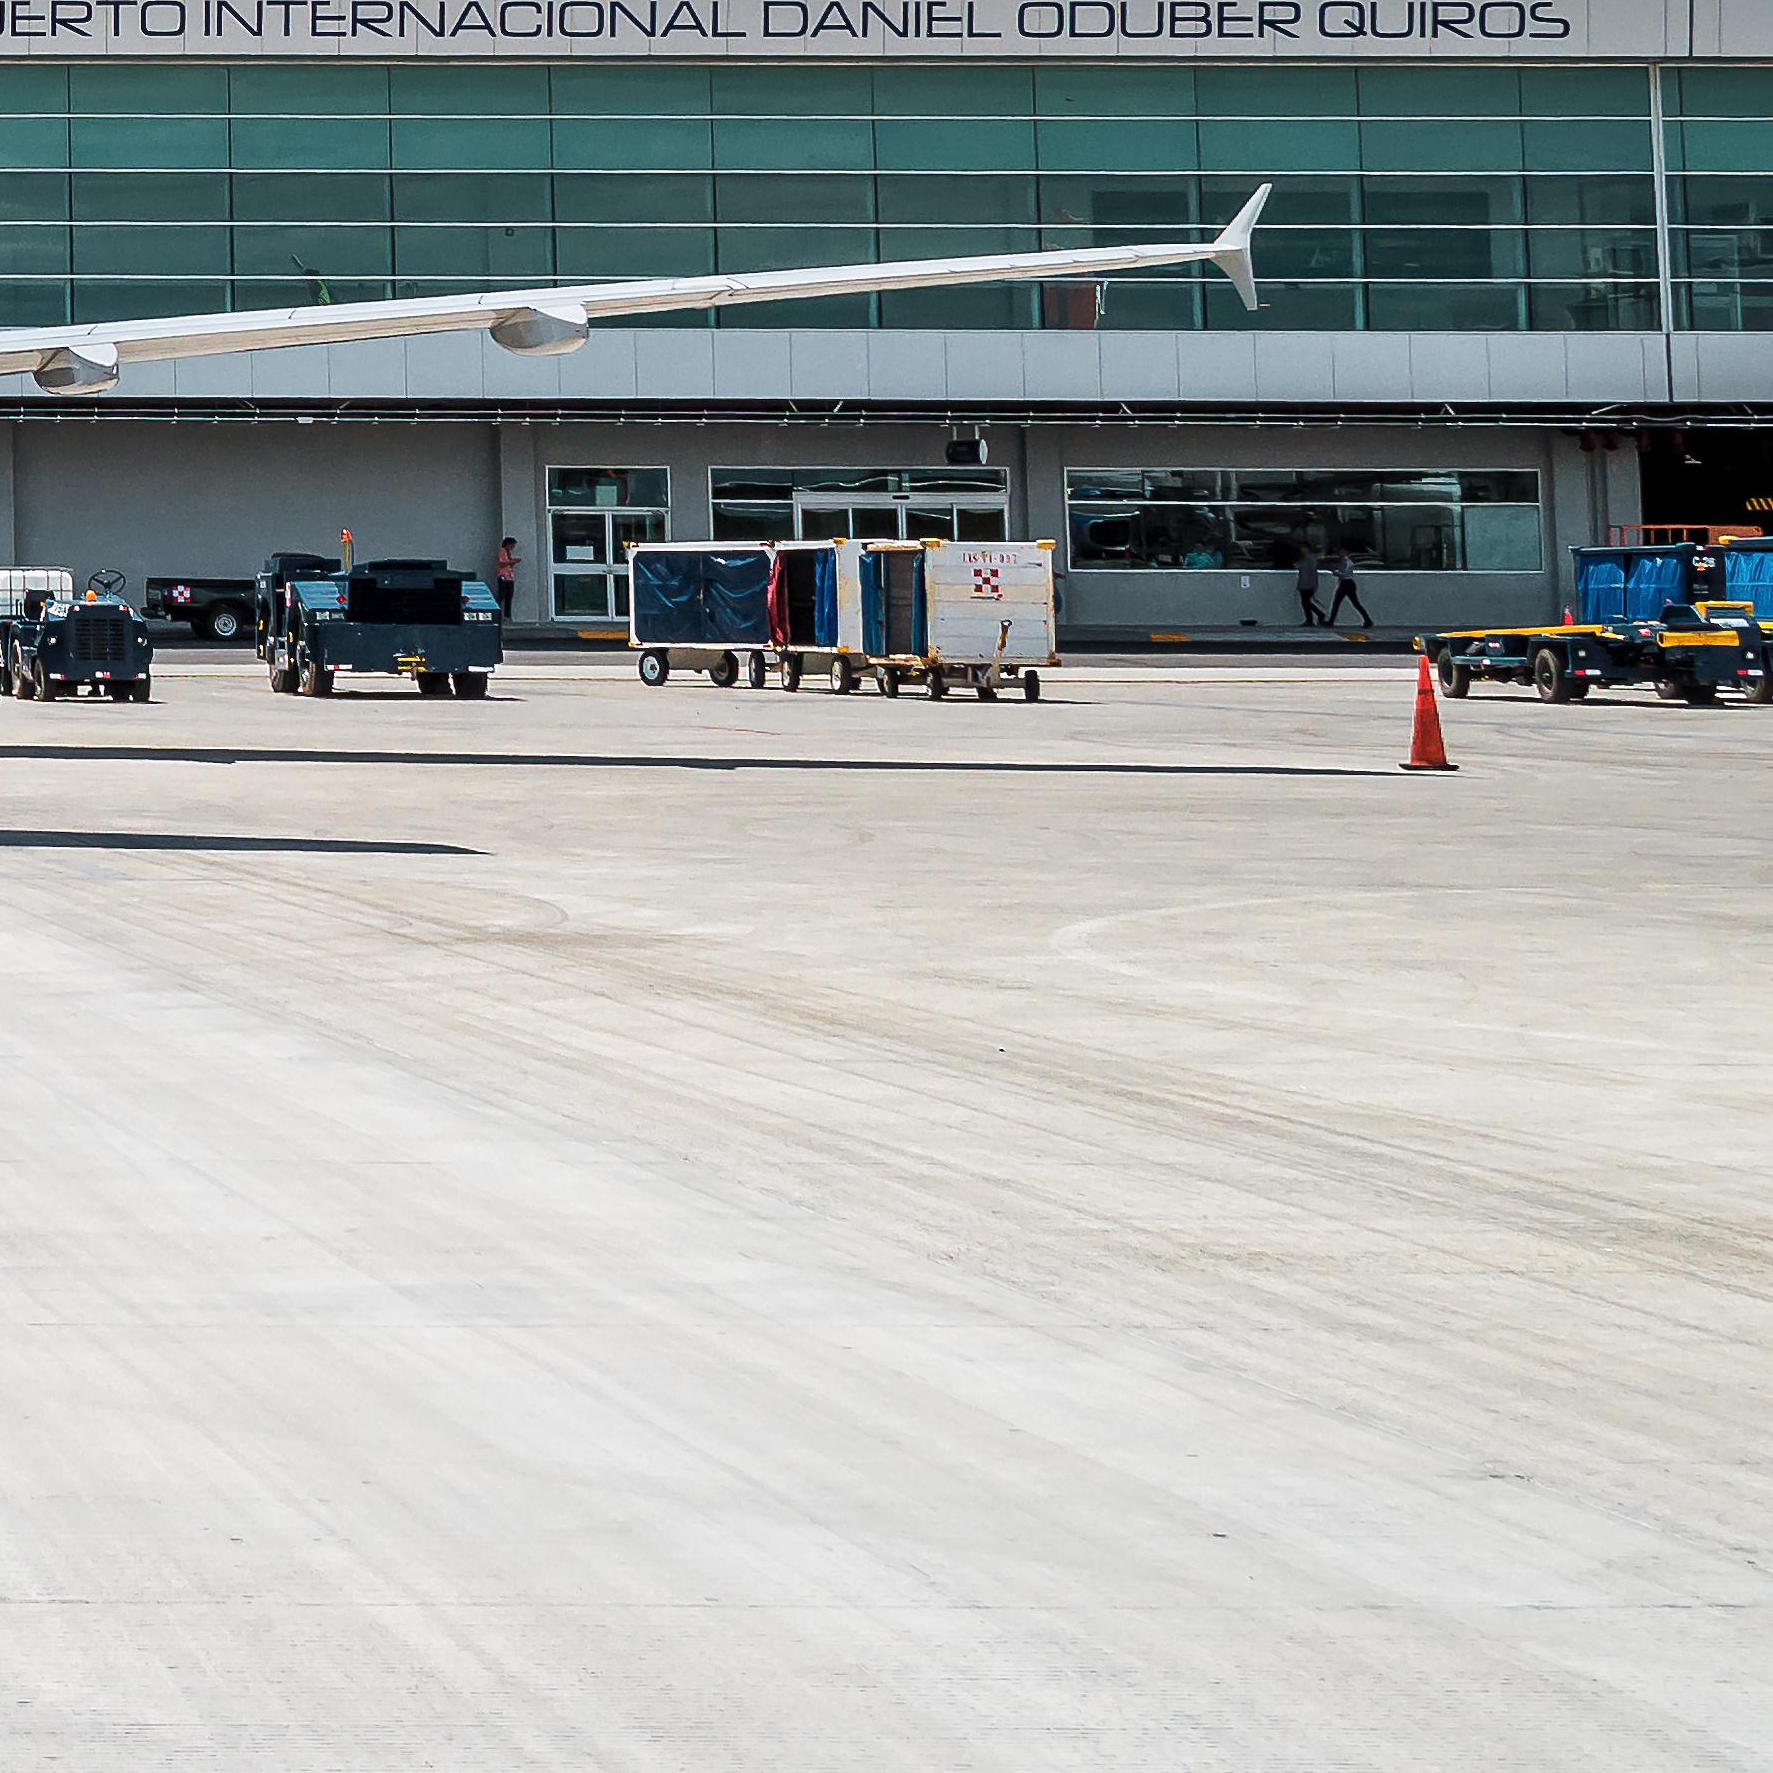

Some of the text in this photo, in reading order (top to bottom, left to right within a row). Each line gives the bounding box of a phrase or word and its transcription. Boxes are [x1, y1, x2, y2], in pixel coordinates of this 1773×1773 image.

[202, 0, 747, 38] INTERNACIONAL
[761, 0, 1003, 38] DANIEL
[1016, 0, 1302, 39] ODUBER
[1317, 0, 1571, 39] QUIROS
